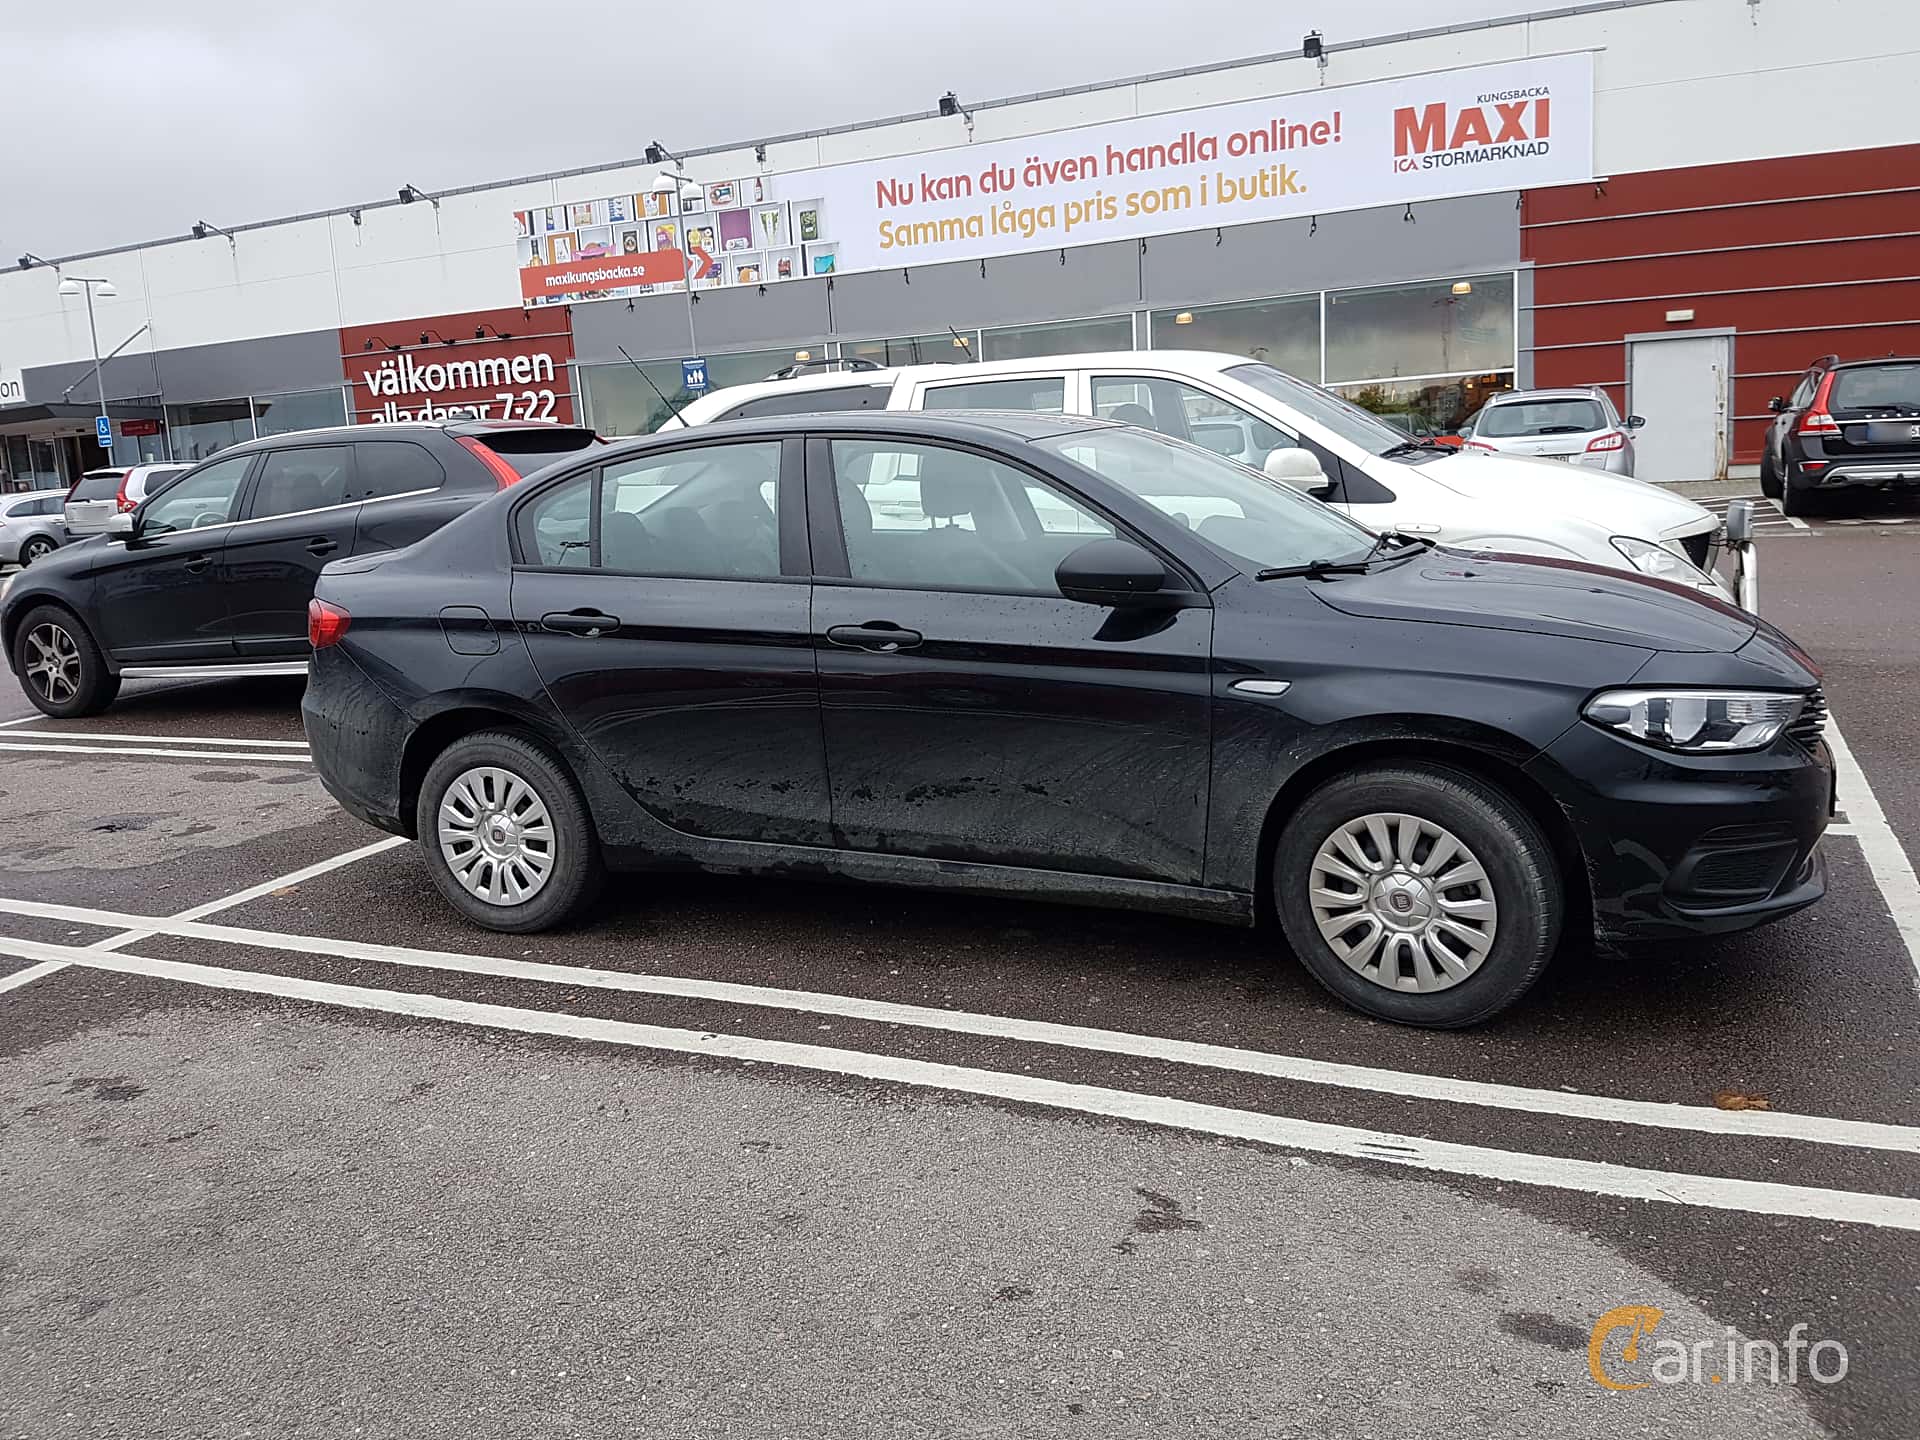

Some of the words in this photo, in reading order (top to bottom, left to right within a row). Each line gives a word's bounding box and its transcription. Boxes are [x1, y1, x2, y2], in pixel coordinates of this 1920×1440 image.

[1477, 86, 1550, 104] KUNGSBACKA
[1394, 98, 1550, 157] MAXI
[876, 178, 914, 209] Nu
[921, 173, 972, 203] kan
[979, 163, 1015, 194] du
[1023, 155, 1098, 188] även
[1106, 131, 1218, 176] handla
[1227, 111, 1341, 157] online!
[1394, 158, 1418, 173] ICA
[1422, 141, 1550, 170] STORMARKNAD
[879, 214, 984, 249] Samma
[991, 201, 1056, 239] låga
[1064, 190, 1118, 232] pris
[1126, 185, 1191, 217] som
[1200, 174, 1207, 206] i
[1216, 163, 1308, 205] butik.
[545, 265, 645, 287] maxikungsbacka.se
[363, 353, 555, 396] välkommen
[496, 389, 558, 422] 7-22
